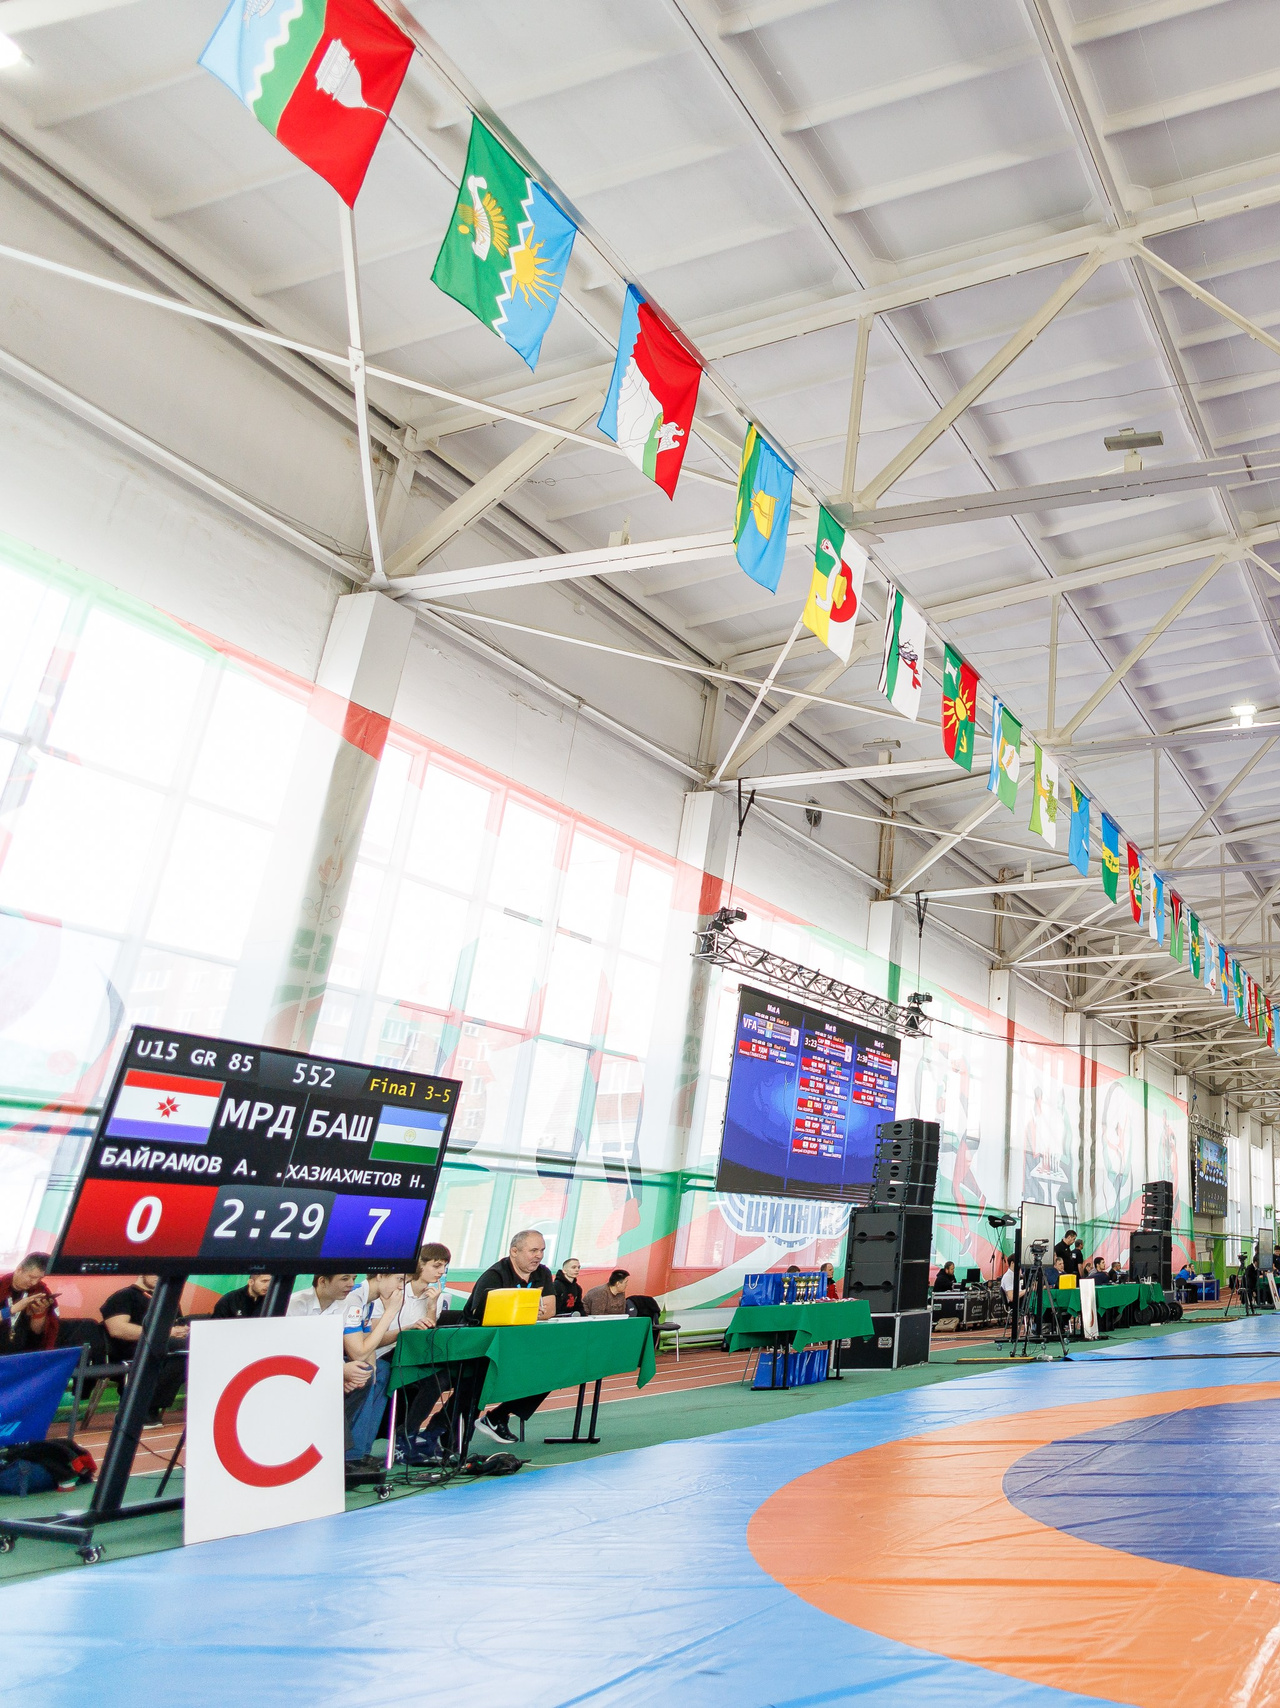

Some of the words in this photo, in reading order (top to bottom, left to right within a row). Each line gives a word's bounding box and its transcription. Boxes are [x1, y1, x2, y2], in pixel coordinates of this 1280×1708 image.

[743, 1018, 757, 1031] VFA
[136, 1039, 179, 1061] U15
[190, 1049, 216, 1067] GR
[228, 1053, 254, 1072] 85
[804, 1037, 817, 1048] 3:23
[292, 1063, 336, 1088] 552
[369, 1078, 416, 1098] Final
[424, 1084, 452, 1103] 3-5
[219, 1099, 296, 1140] МРД
[306, 1111, 374, 1143] БАШ
[100, 1146, 222, 1175] БАЙРАМОВ
[233, 1158, 257, 1176] А.
[409, 1174, 426, 1189] Н.
[126, 1195, 163, 1243] 0
[213, 1198, 325, 1240] 2:29
[364, 1207, 391, 1246] 7
[213, 1354, 323, 1488] C
